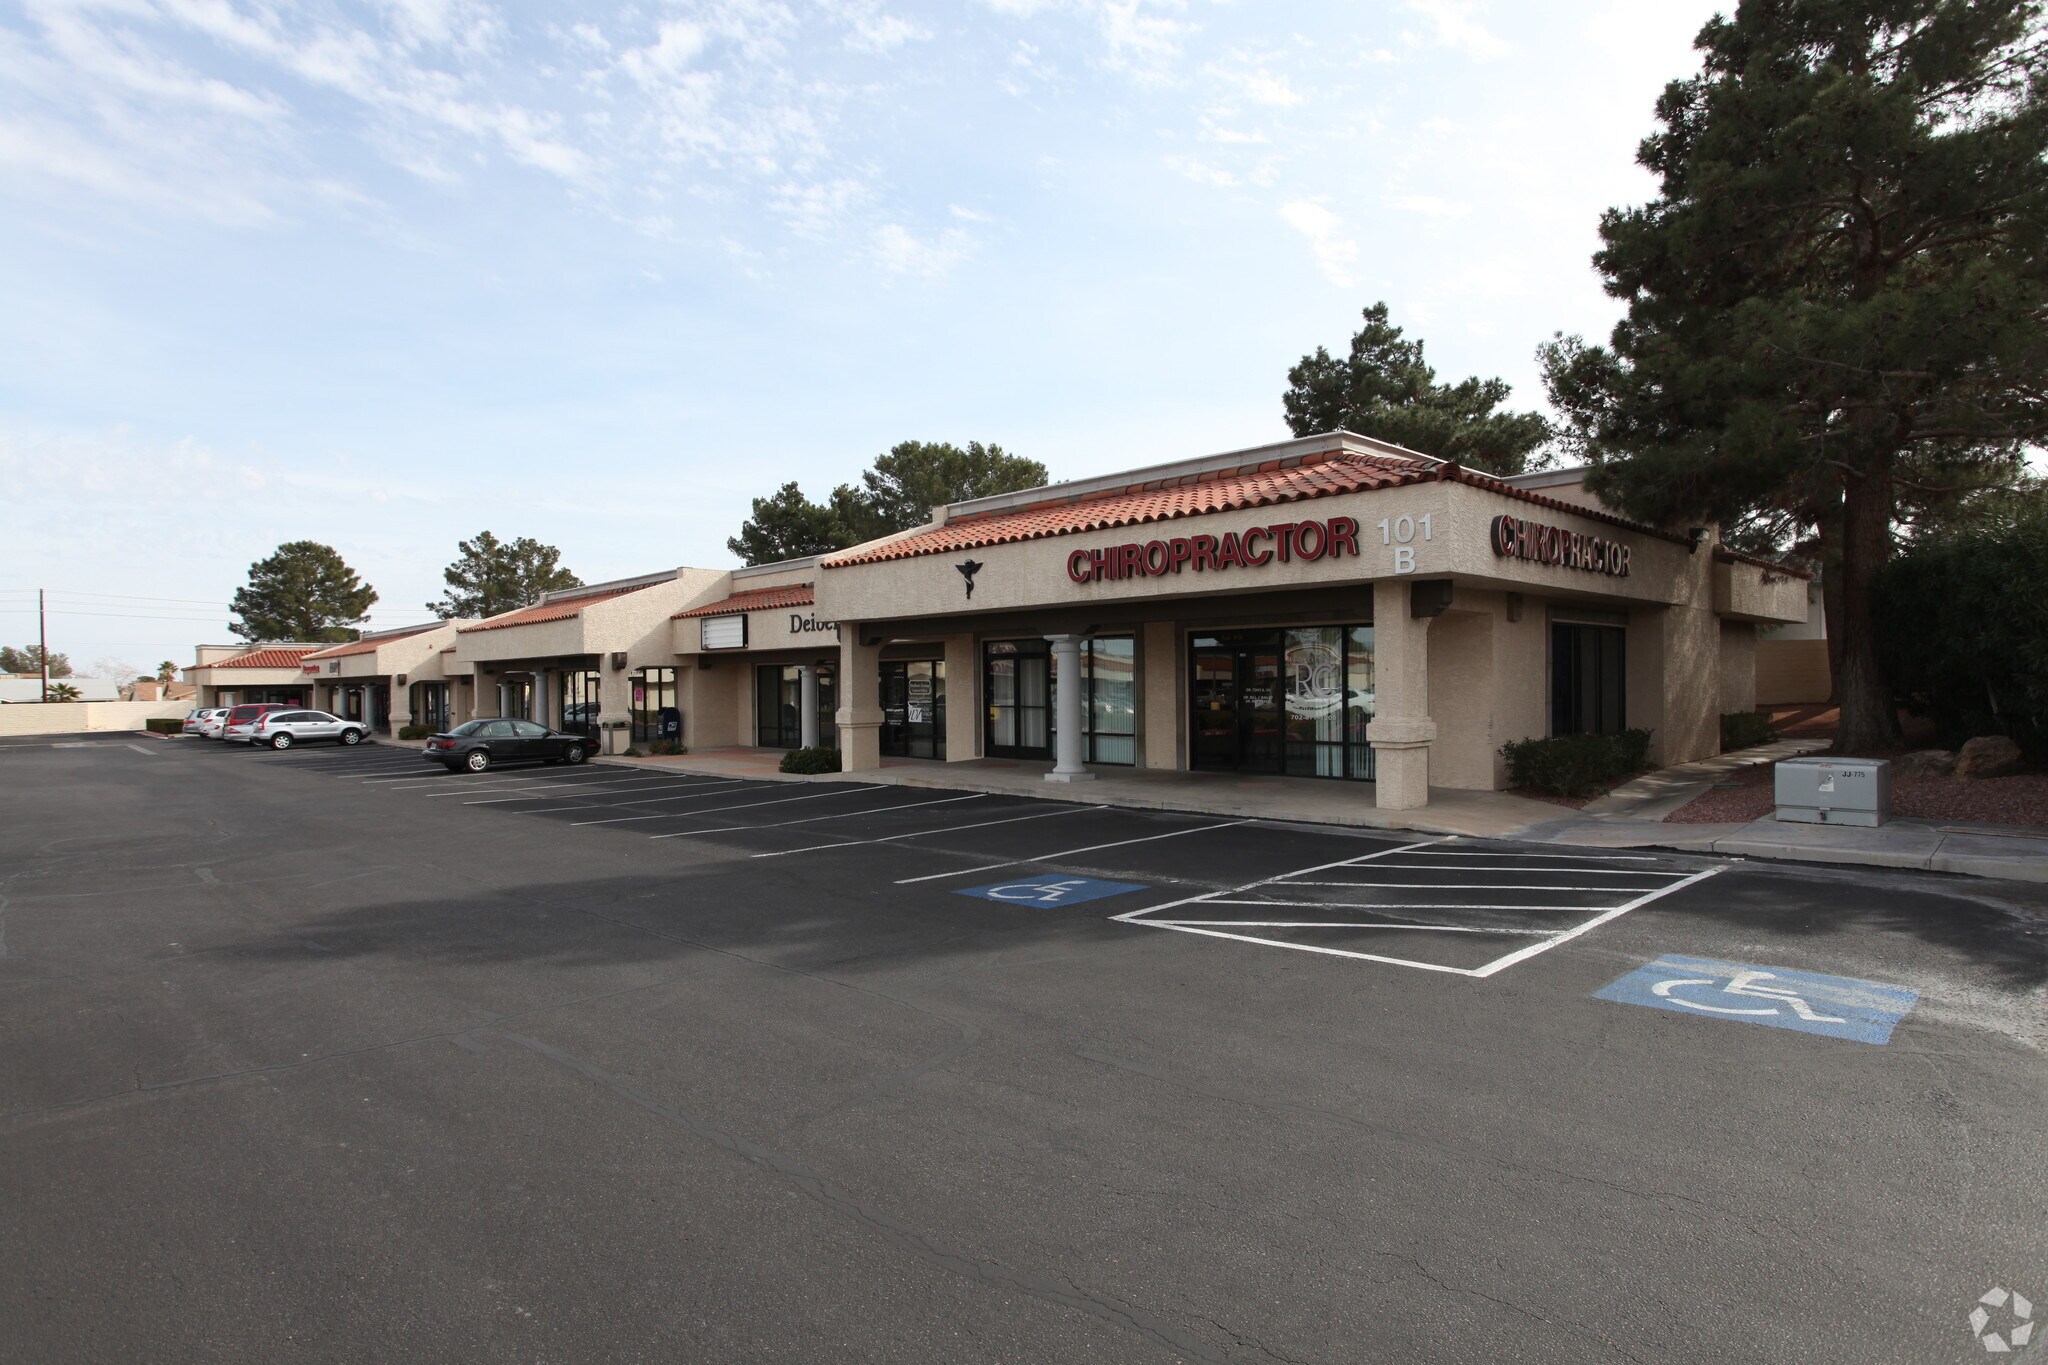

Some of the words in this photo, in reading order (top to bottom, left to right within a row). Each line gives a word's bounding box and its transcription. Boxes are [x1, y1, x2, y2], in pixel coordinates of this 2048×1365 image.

[1066, 515, 1359, 584] CHIROPRACTOR
[1377, 514, 1433, 546] 101
[1491, 514, 1632, 577] CHIROPRACTOR
[1394, 546, 1416, 575] B
